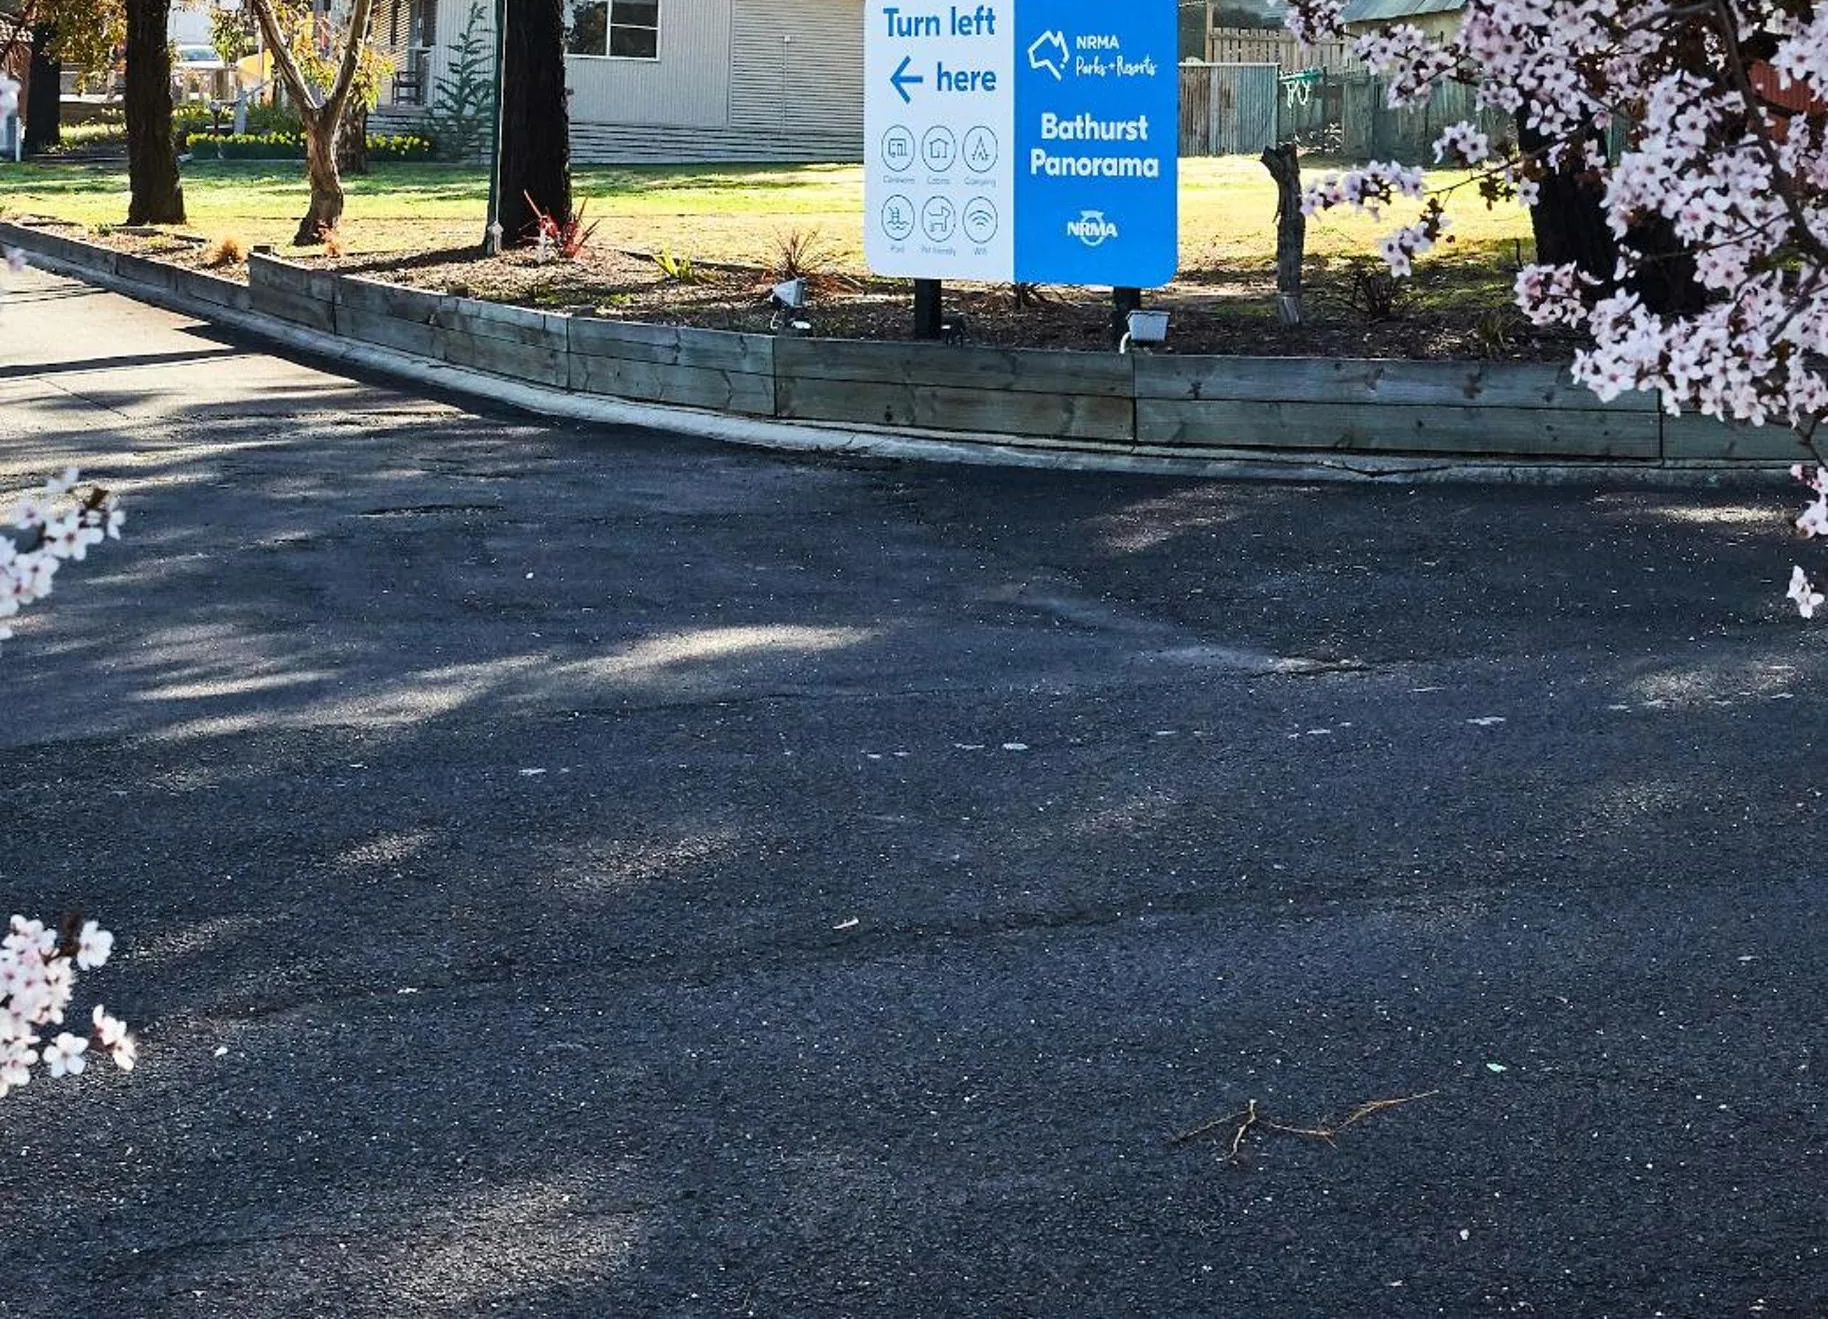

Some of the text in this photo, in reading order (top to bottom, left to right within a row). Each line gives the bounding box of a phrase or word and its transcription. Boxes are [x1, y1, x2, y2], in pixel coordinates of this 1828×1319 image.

[882, 4, 997, 38] Turn left
[1076, 35, 1120, 50] NRMA
[936, 61, 998, 92] here
[1040, 112, 1149, 141] Bathurst
[1029, 147, 1160, 178] Panorama
[1067, 221, 1118, 238] NRMA
